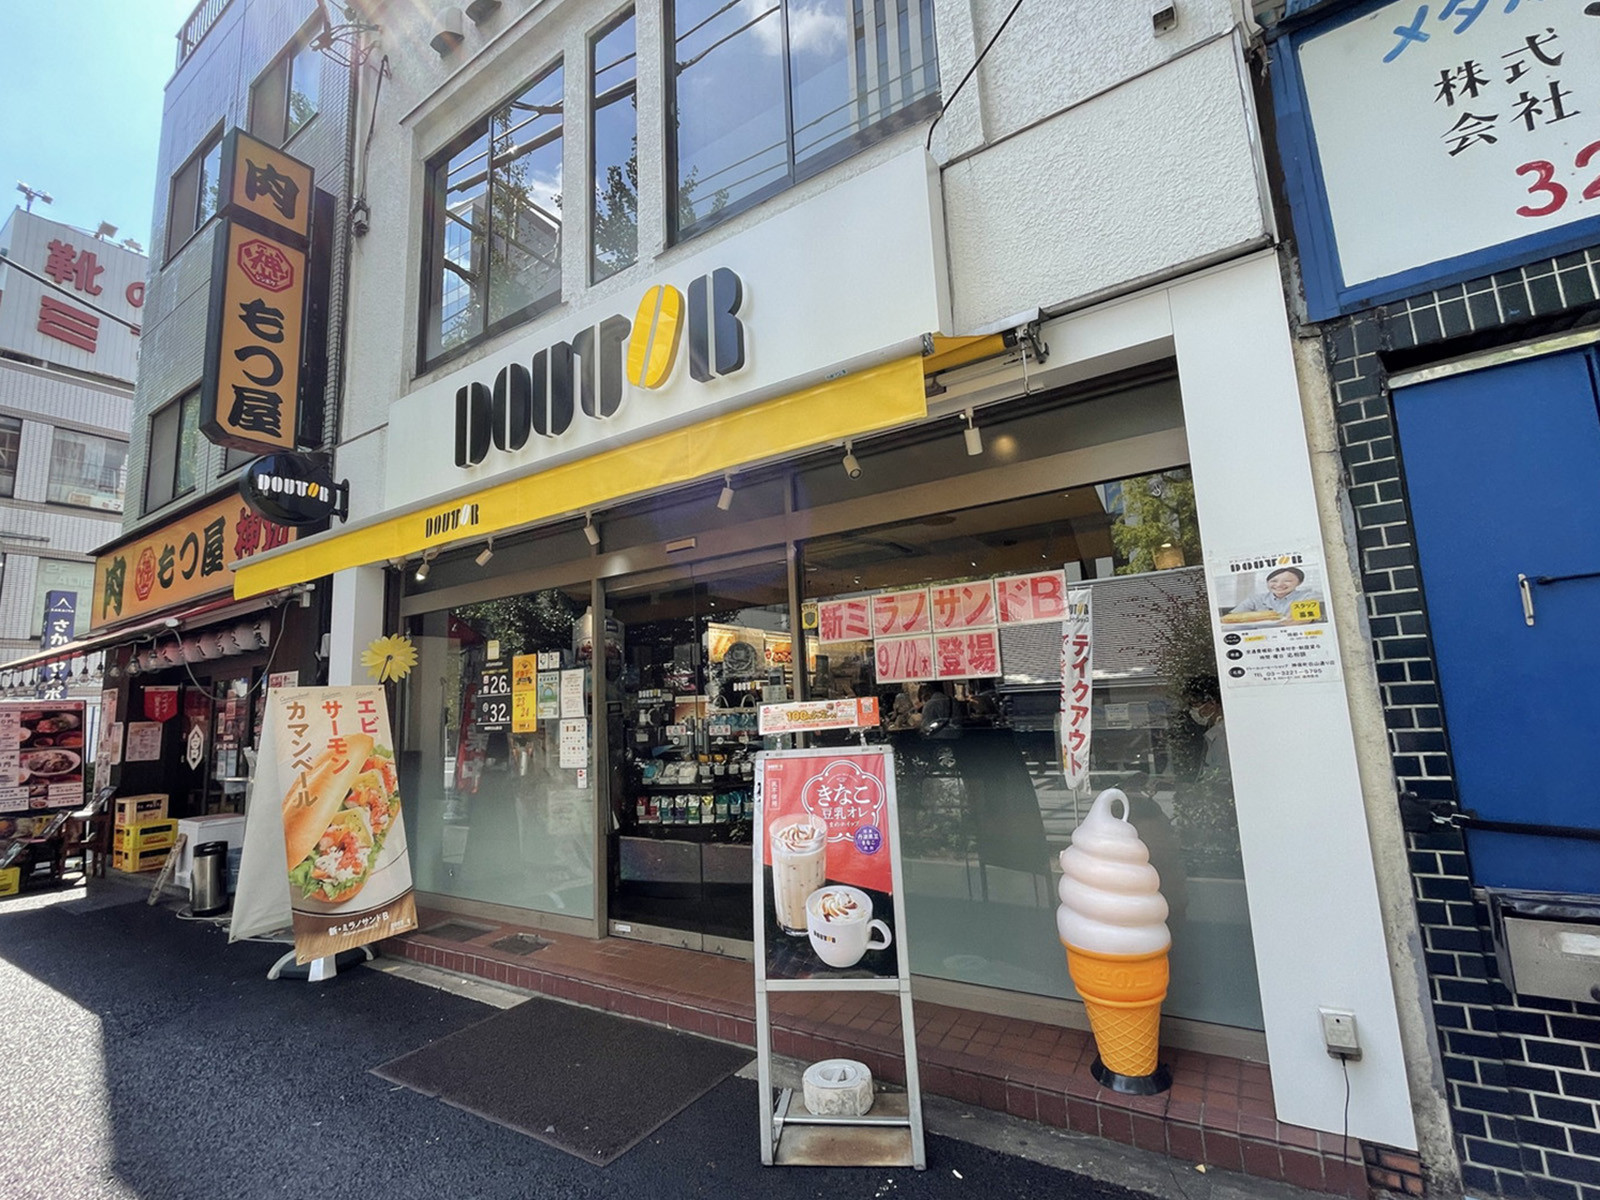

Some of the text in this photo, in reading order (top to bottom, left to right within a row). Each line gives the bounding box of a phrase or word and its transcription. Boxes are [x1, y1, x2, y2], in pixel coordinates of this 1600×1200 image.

[1433, 27, 1565, 107] 株式
[1440, 80, 1581, 157] 会社
[246, 158, 300, 220] 肉
[228, 298, 285, 438] もつ屋
[455, 266, 748, 469] DOUTOR
[258, 474, 329, 503] DOUTOR
[425, 503, 479, 538] DOUTOR
[103, 556, 127, 620] 肉
[158, 515, 226, 589] もつ屋
[1230, 555, 1303, 572] DOUTOR
[820, 576, 1063, 641] 新ミラノサンドB
[490, 675, 507, 694] 26
[938, 633, 996, 677] 登場
[357, 700, 380, 735] エビ
[490, 703, 507, 722] 32
[1068, 634, 1089, 776] テイクアウト
[286, 701, 318, 810] カマンベール
[322, 700, 351, 776] サーモン
[817, 783, 871, 806] きなこ
[822, 807, 868, 820] 豆乳オレ
